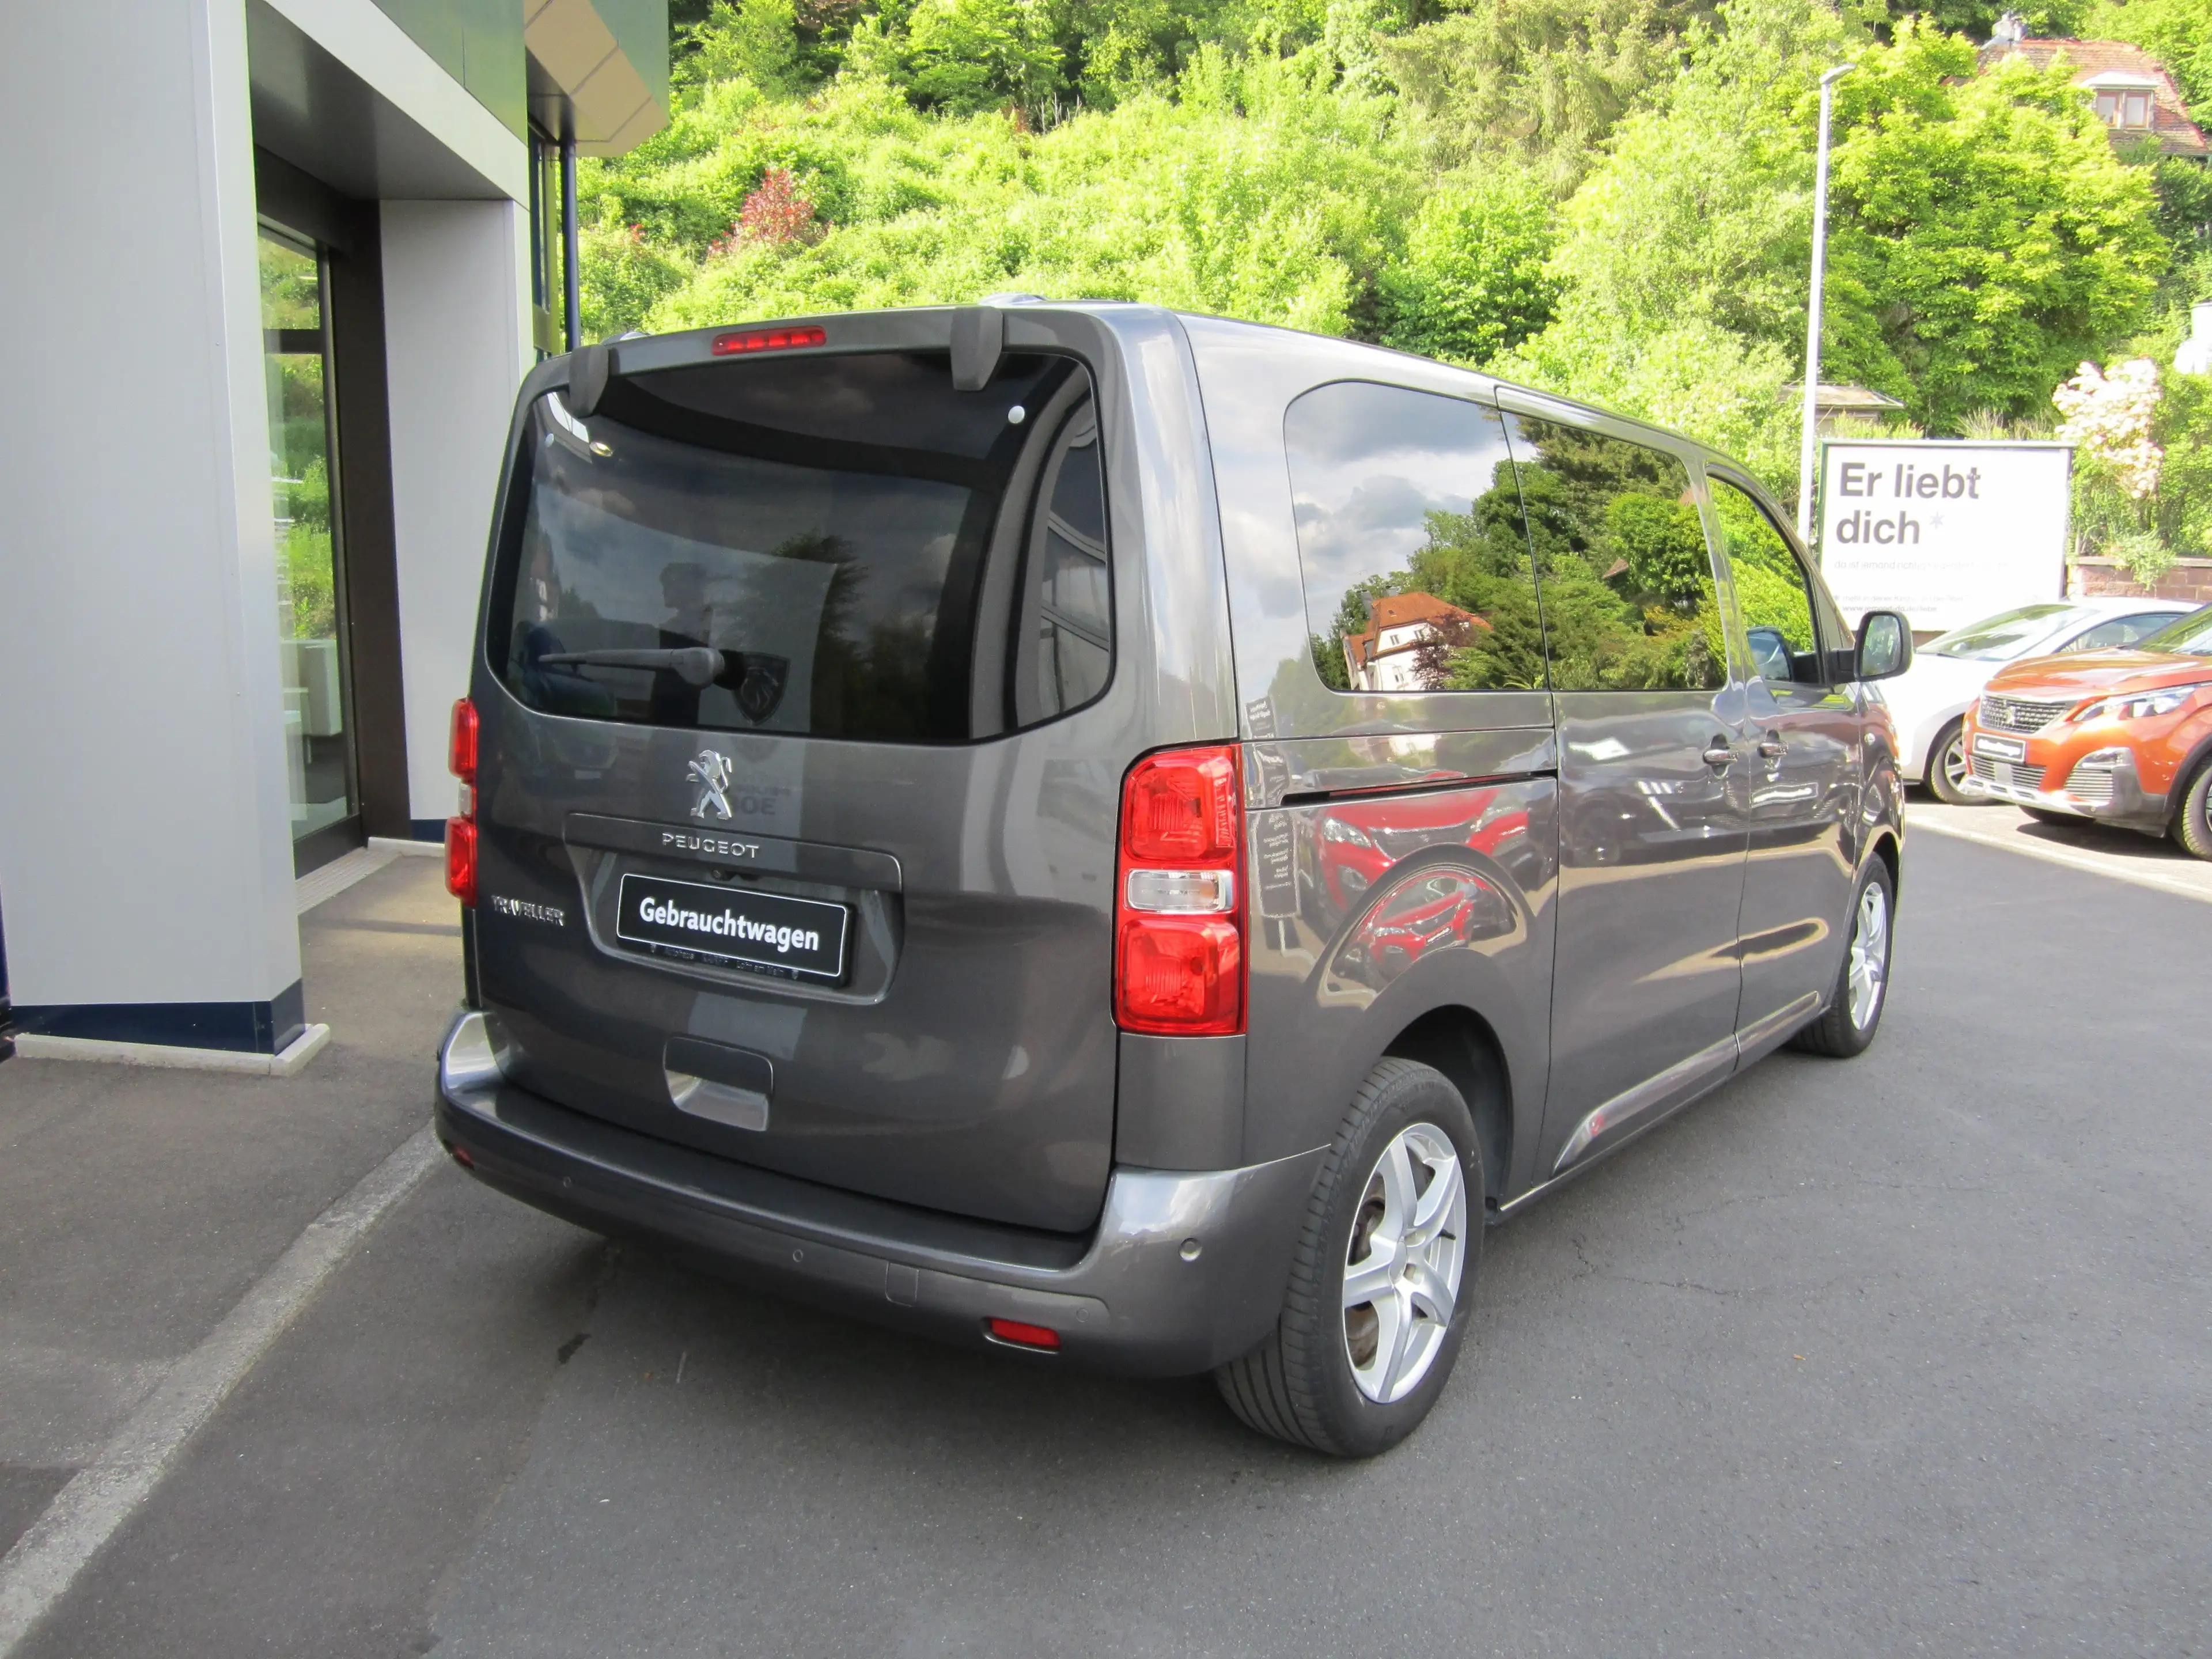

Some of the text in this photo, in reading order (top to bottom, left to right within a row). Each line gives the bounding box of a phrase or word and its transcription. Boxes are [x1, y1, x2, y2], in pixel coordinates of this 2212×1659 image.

[1839, 462, 1981, 499] Er liebt
[1836, 509, 1920, 544] dich
[662, 832, 760, 859] PEUGEOT
[491, 895, 565, 926] TRAVELLER
[639, 896, 819, 953] Gebrauchtwagen
